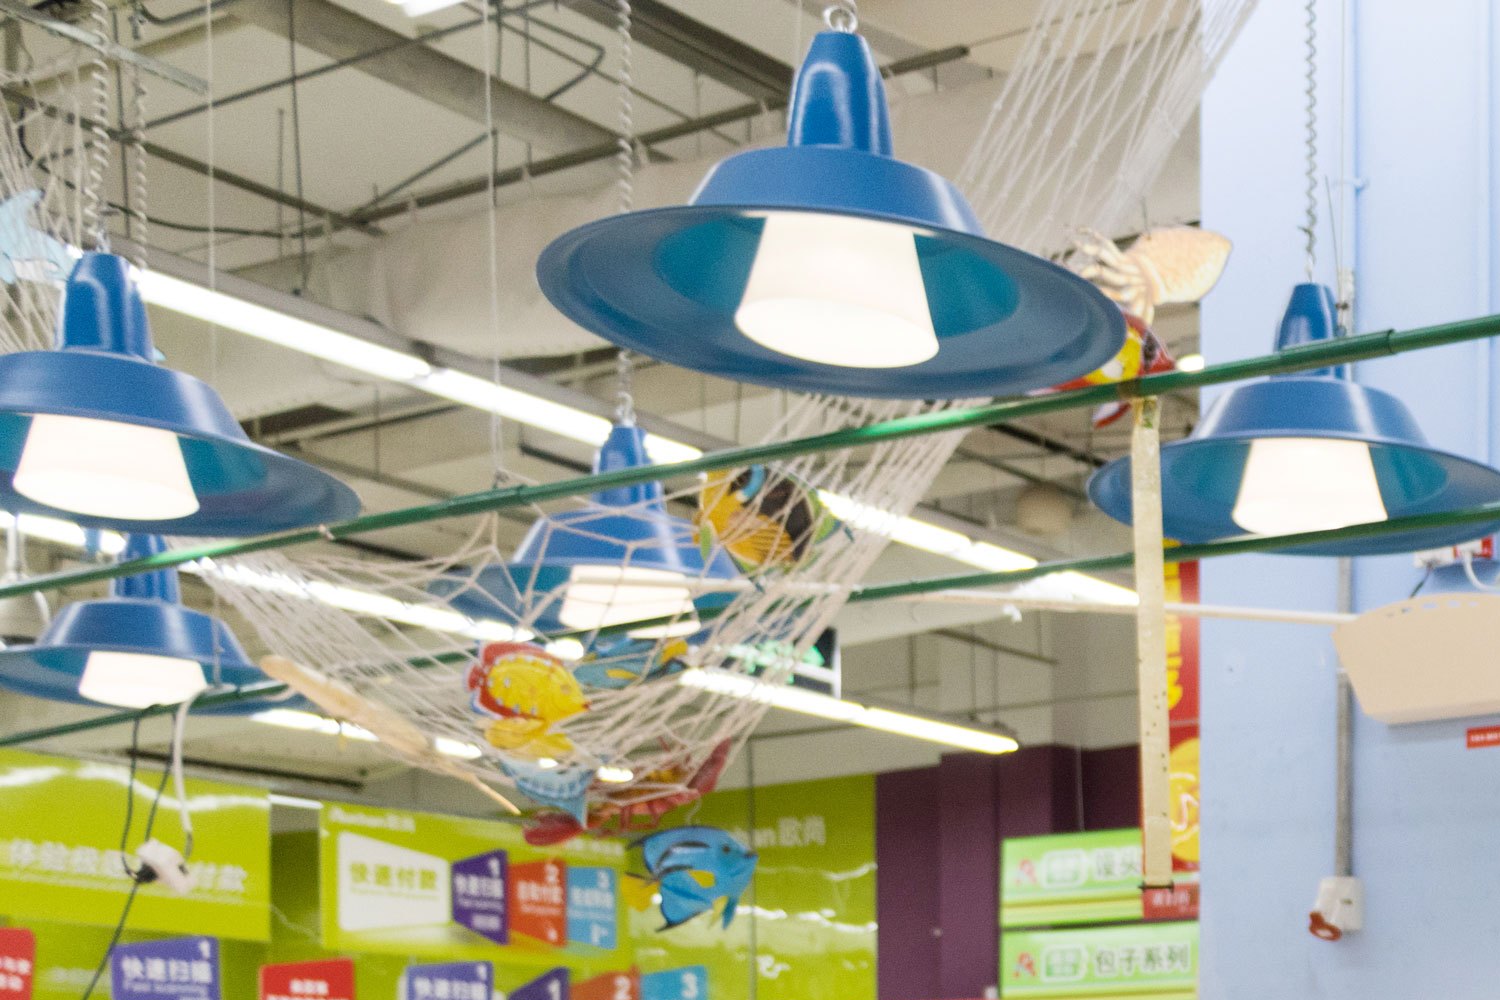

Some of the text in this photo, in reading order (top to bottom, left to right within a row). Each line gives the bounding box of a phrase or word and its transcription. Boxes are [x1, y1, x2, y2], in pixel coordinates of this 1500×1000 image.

[1095, 944, 1190, 978] 包子系列
[680, 972, 698, 999] 3
